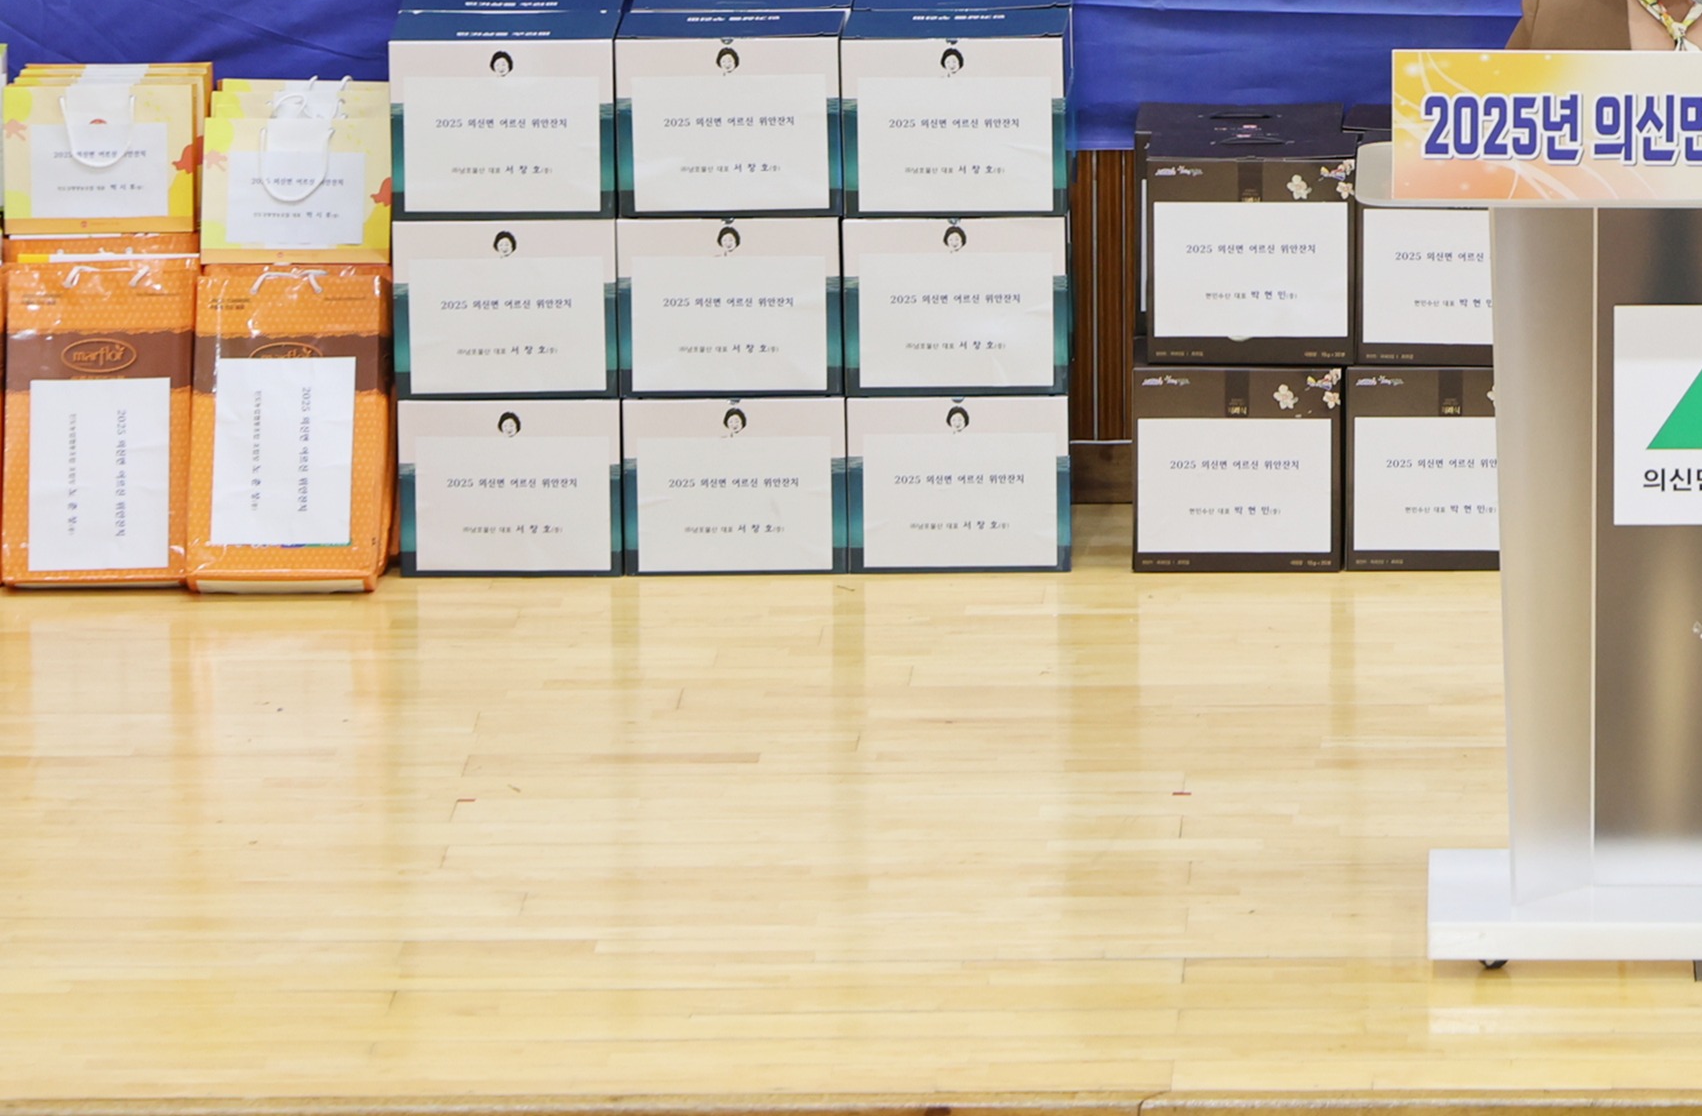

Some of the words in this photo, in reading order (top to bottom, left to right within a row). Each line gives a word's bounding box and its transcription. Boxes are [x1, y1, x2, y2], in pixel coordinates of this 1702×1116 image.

[435, 118, 464, 129] 2025
[467, 118, 495, 129] 의신면
[498, 118, 527, 129] 어르신
[531, 117, 568, 129] 위안잔치
[663, 117, 691, 128] 2025
[695, 116, 723, 128] 의신면
[726, 116, 754, 127] 어르신
[758, 115, 795, 127] 위안잔치
[888, 118, 916, 129] 2025
[920, 118, 948, 129] 의신면
[951, 118, 979, 129] 어르신
[983, 117, 1020, 129] 위안잔치
[1424, 94, 1582, 163] 2025년
[1185, 244, 1213, 254] 2025
[1217, 243, 1244, 255] 의신면
[1248, 243, 1276, 255] 어르신
[1280, 243, 1316, 255] 위안잔치
[1394, 251, 1422, 261] 2025
[1426, 251, 1453, 263] 의신면
[1457, 251, 1485, 263] 어르신
[440, 299, 469, 311] 2025
[472, 299, 500, 311] 의신면
[503, 299, 531, 310] 어르신
[535, 298, 572, 310] 위안잔치
[662, 297, 691, 308] 2025
[694, 297, 722, 308] 의신면
[725, 297, 753, 308] 어르신
[757, 296, 794, 308] 위안잔치
[889, 294, 918, 305] 2025
[921, 293, 949, 305] 의신면
[952, 293, 980, 305] 어르신
[984, 293, 1021, 304] 위안잔치
[1169, 459, 1197, 470] 2025
[1201, 459, 1228, 471] 의신면
[1232, 459, 1259, 471] 어르신
[1263, 459, 1300, 471] 위안잔치
[1385, 458, 1413, 469] 2025
[1417, 458, 1444, 469] 의신면
[1448, 458, 1475, 469] 어르신
[446, 477, 475, 489] 2025
[478, 477, 505, 489] 의신면
[509, 477, 537, 489] 어르신
[541, 477, 578, 489] 위안잔치
[668, 478, 696, 489] 2025
[700, 477, 727, 489] 의신면
[731, 477, 759, 489] 어르신
[763, 477, 799, 489] 위안잔치
[894, 474, 922, 485] 2025
[925, 474, 953, 486] 의신면
[956, 473, 984, 485] 어르신
[988, 473, 1025, 485] 위안잔치
